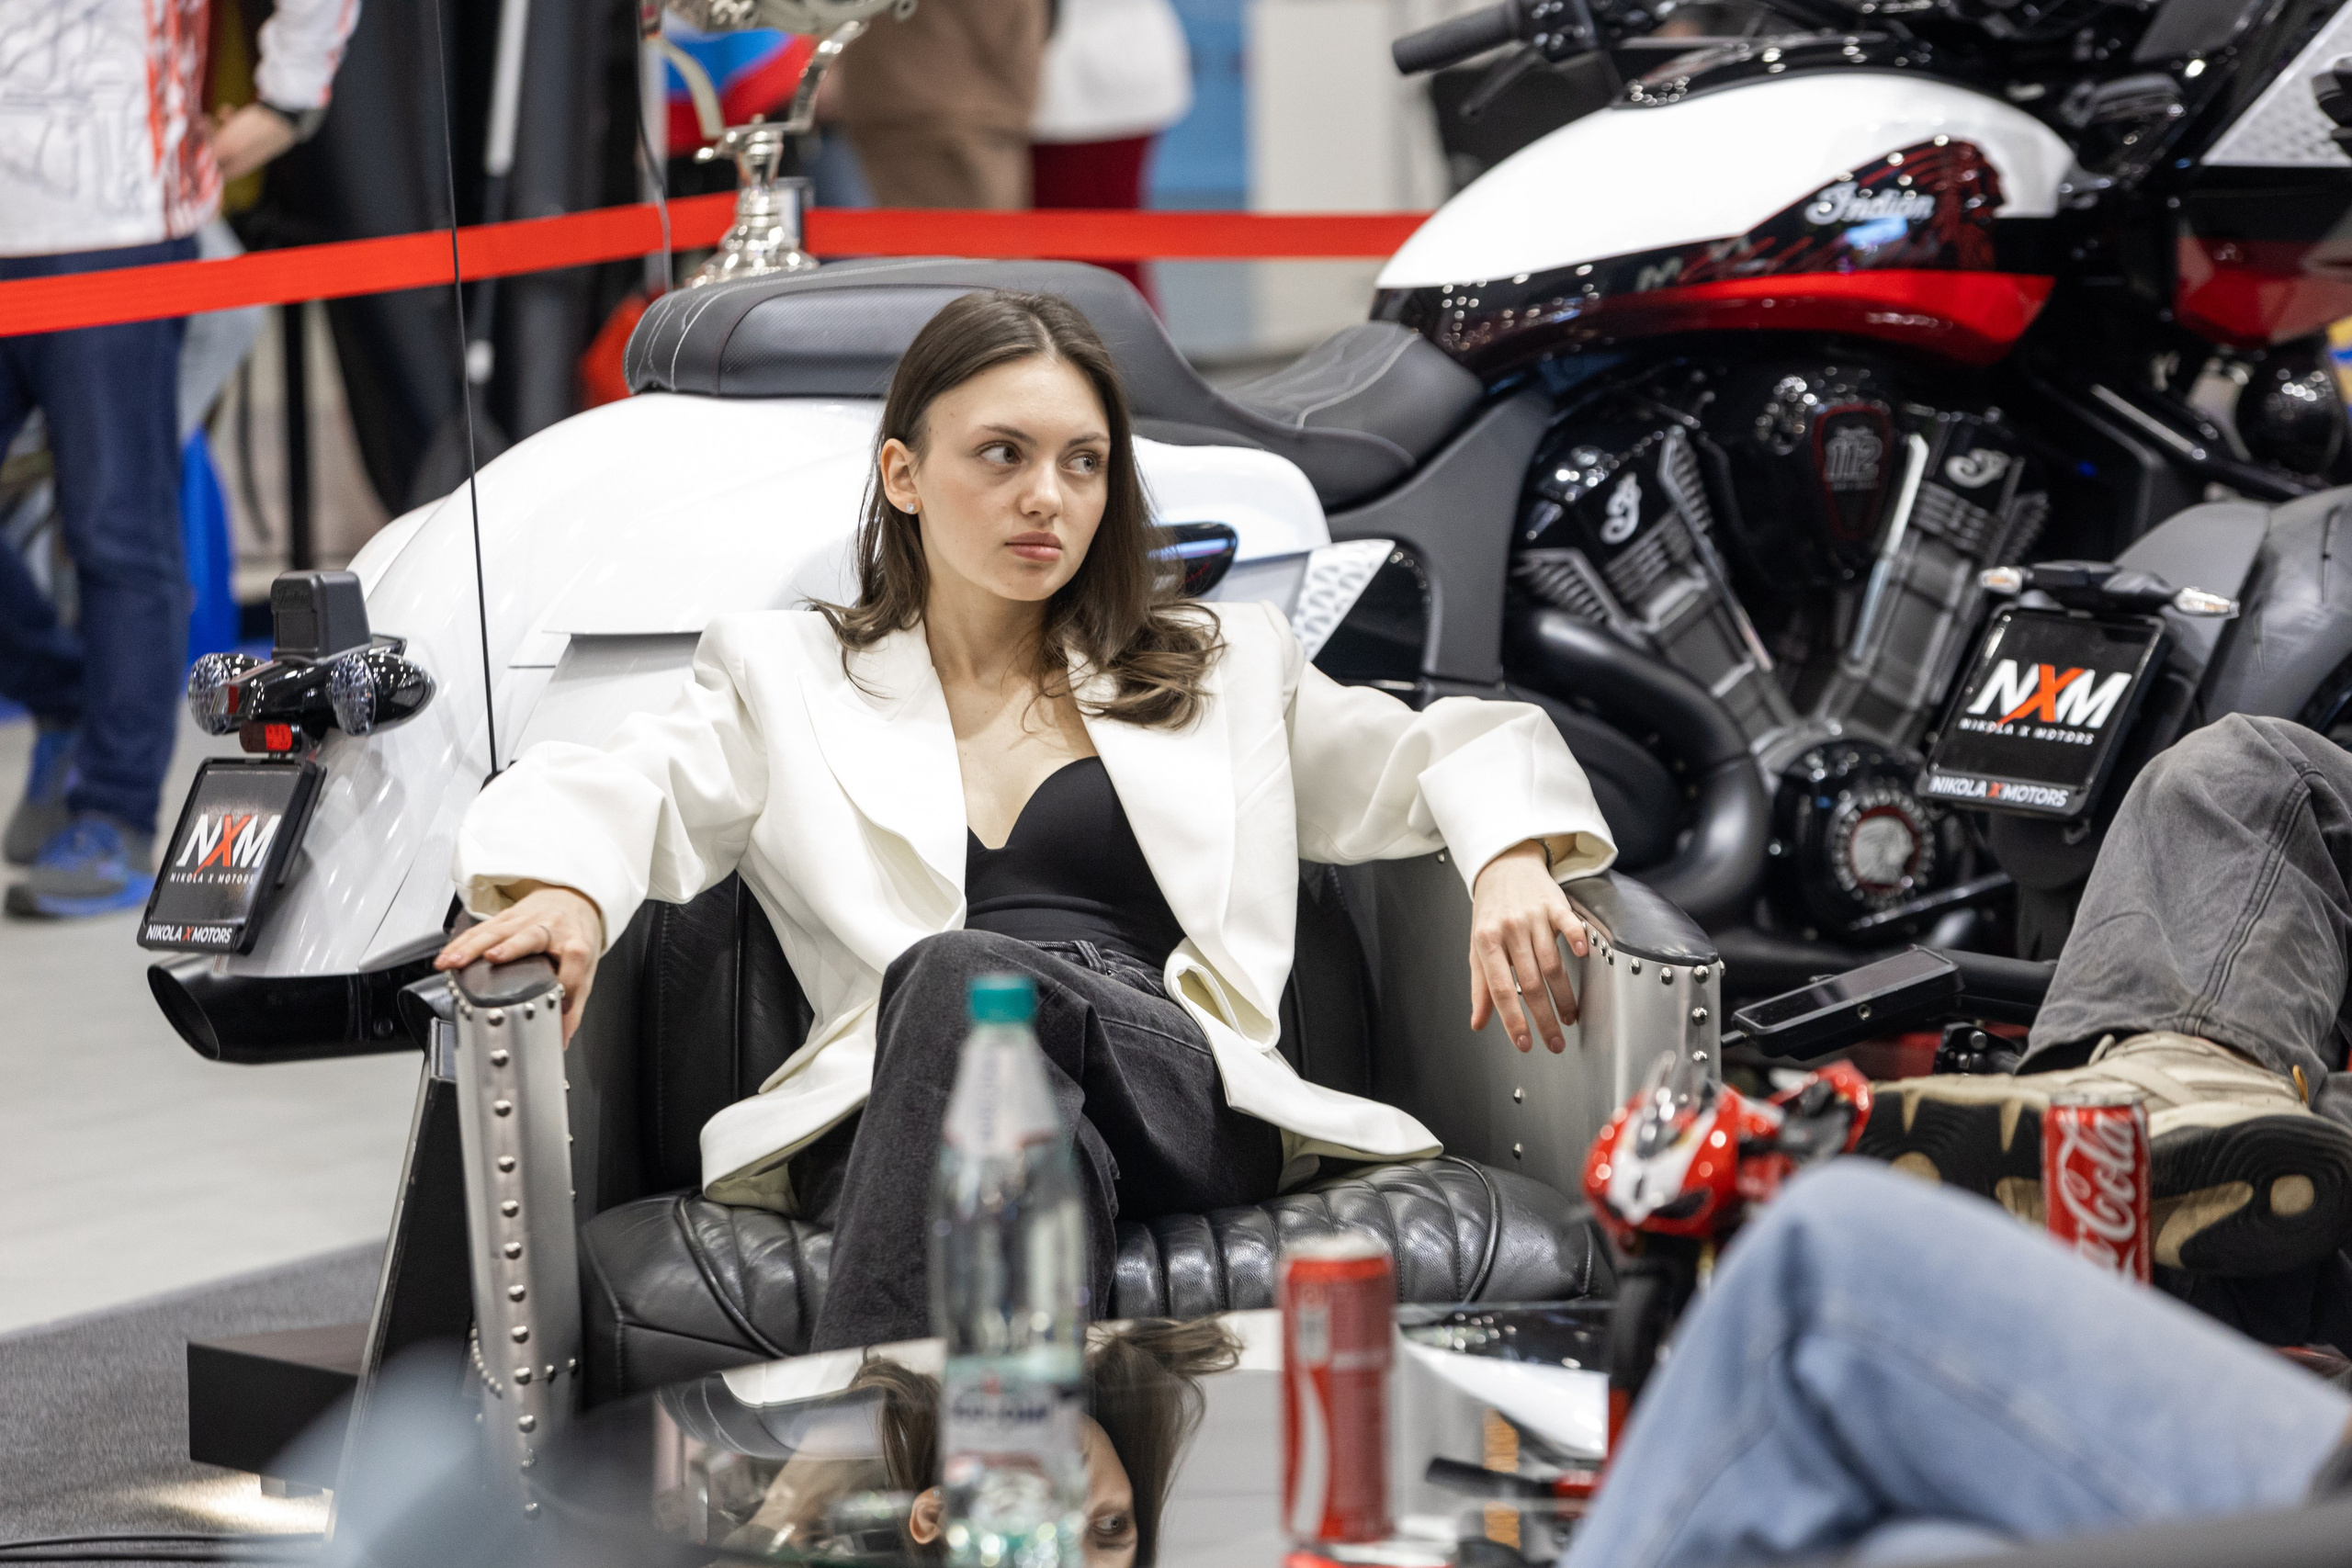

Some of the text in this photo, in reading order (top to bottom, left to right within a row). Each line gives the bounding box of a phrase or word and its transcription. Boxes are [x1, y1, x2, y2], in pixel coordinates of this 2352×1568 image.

[1804, 181, 1936, 225] Indian
[1966, 659, 2132, 730] NXM
[1958, 717, 2095, 745] NIKOLA X MOTORS
[1929, 775, 1987, 797] NIKOLA
[2000, 785, 2069, 807] MOTORS
[175, 814, 282, 874] NXM
[169, 872, 254, 885] NIKOLA X MOTORS
[145, 924, 232, 944] NIKOLA X MOTORS
